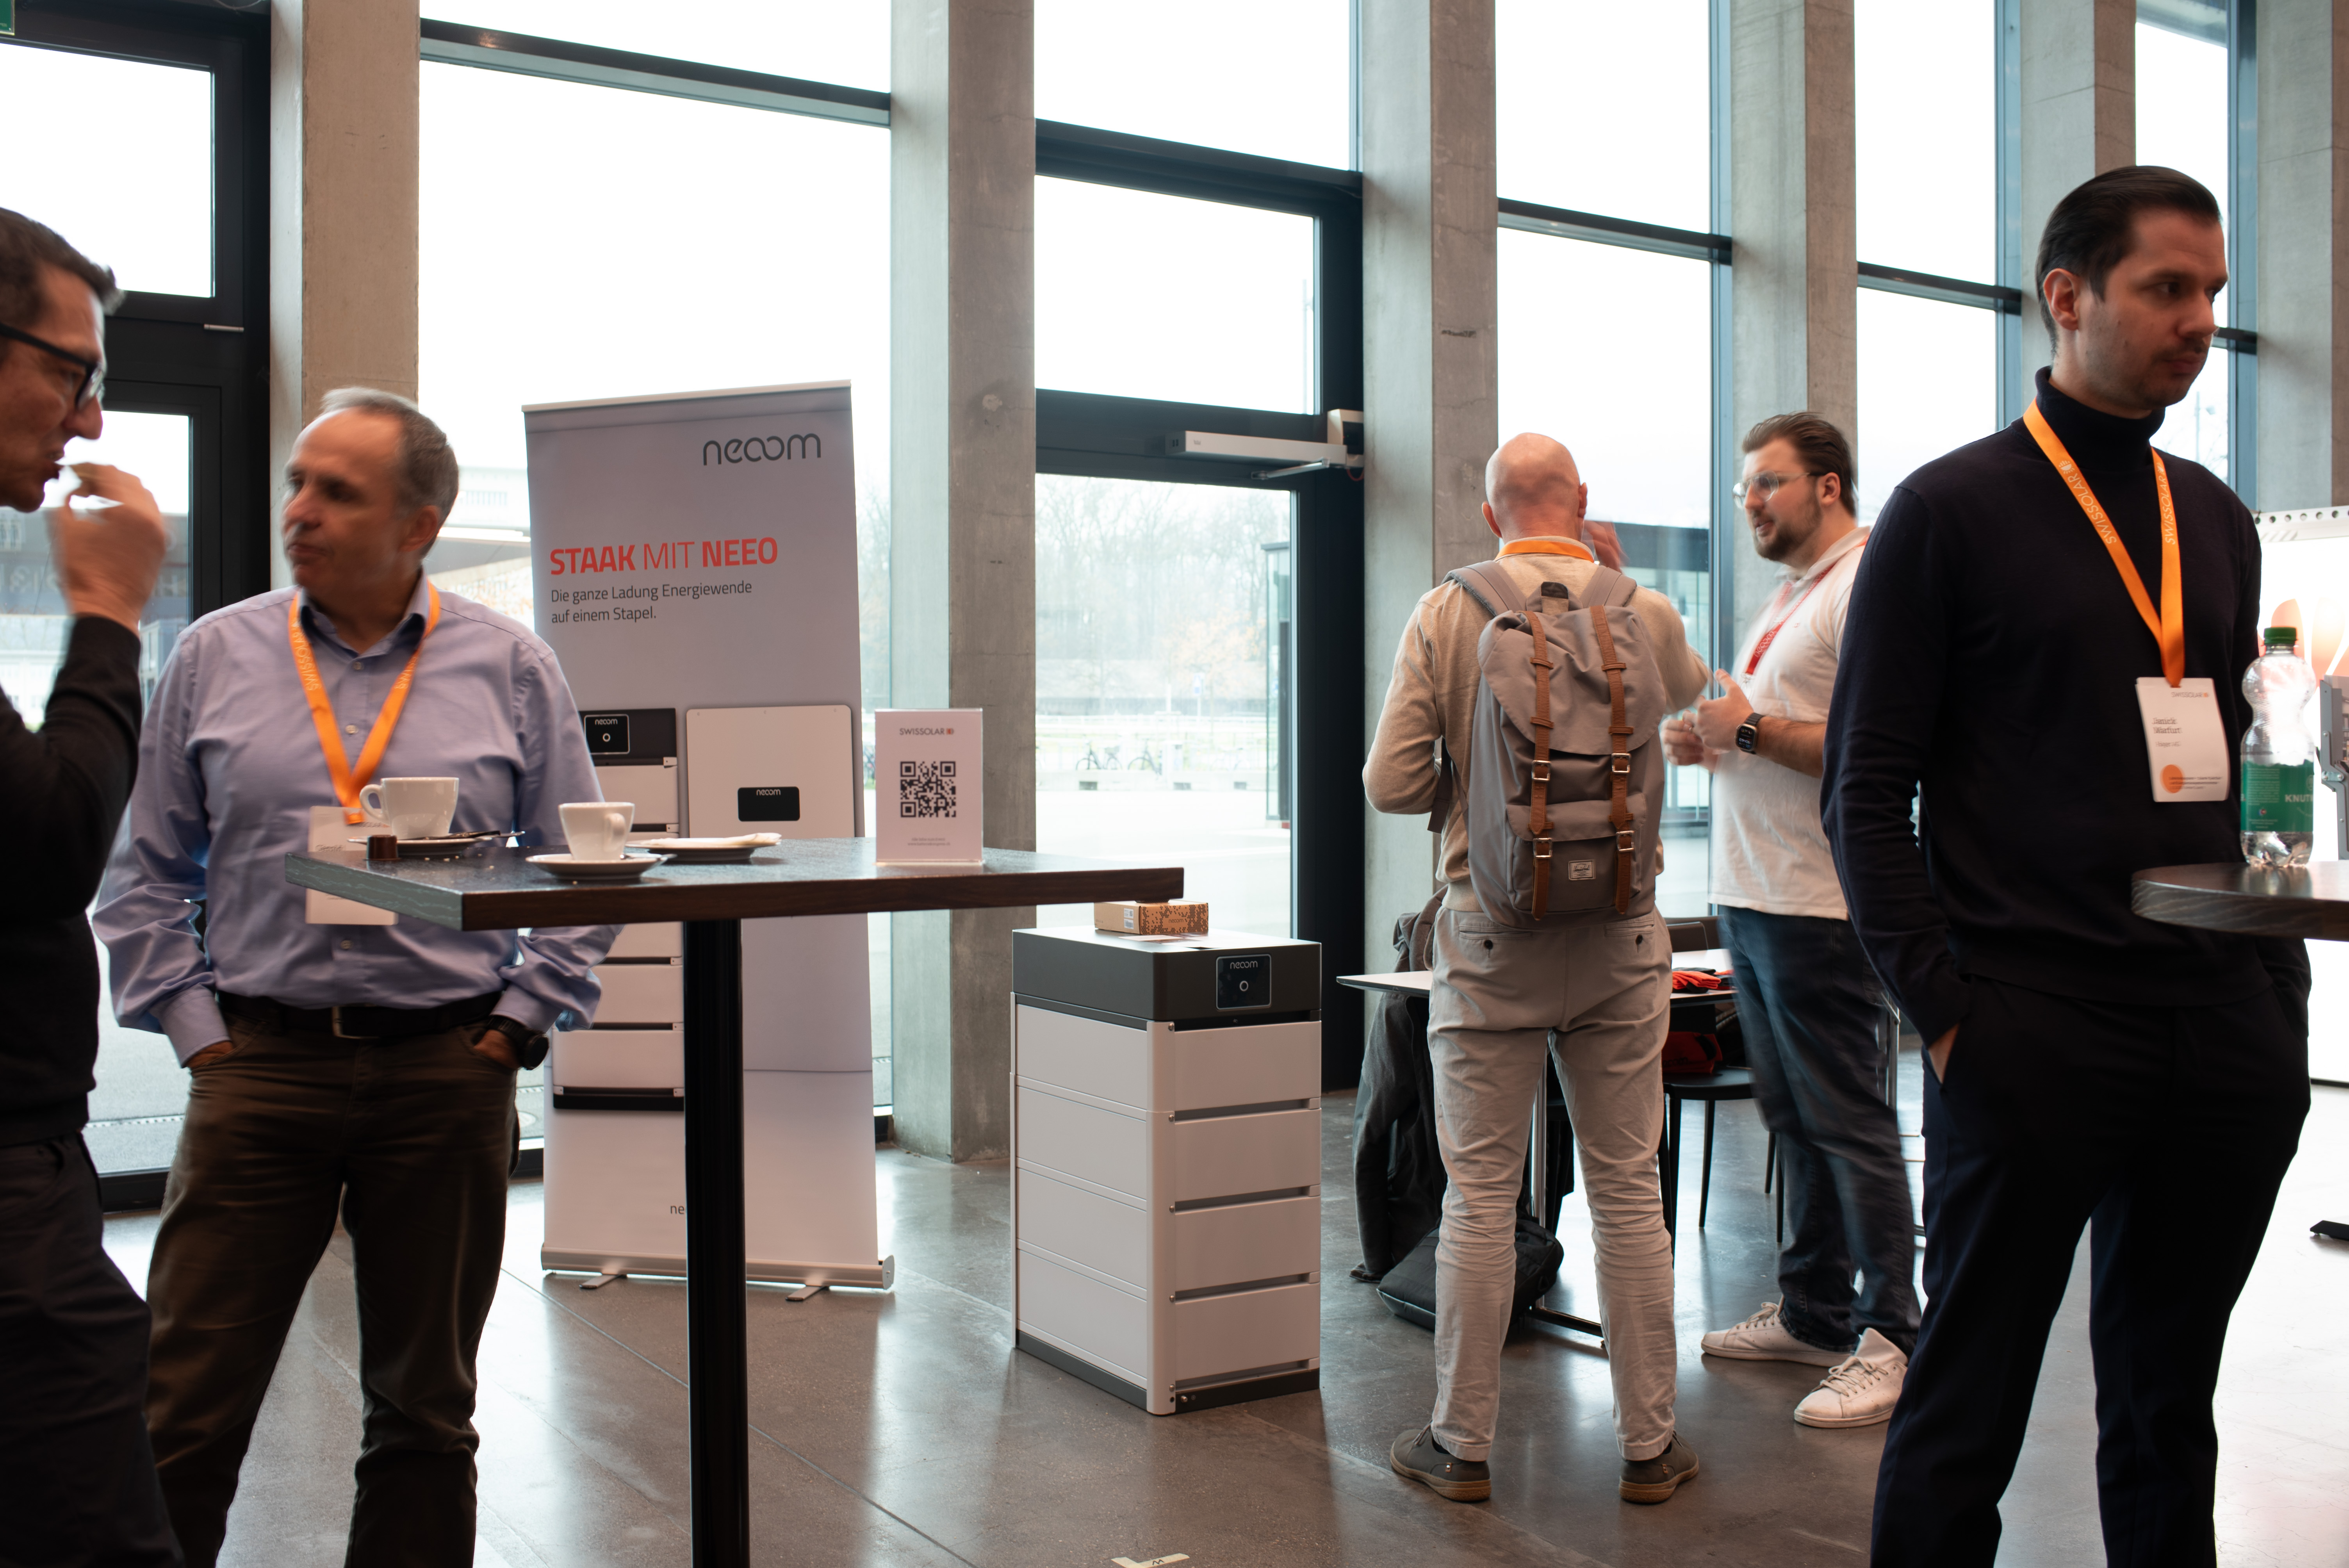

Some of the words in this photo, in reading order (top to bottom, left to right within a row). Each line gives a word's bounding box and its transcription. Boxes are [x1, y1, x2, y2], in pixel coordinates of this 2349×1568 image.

[703, 433, 821, 466] neoom
[2067, 473, 2117, 544] SWISSOLAR
[2158, 476, 2175, 545] SWISSOLAR
[550, 545, 636, 575] STAAK
[643, 541, 695, 570] MIT
[702, 536, 778, 567] NEEO
[552, 589, 569, 602] Die
[573, 590, 608, 605] ganze
[612, 585, 659, 601] Ladung
[663, 580, 752, 599] Energiewende
[552, 609, 570, 623] auf
[573, 609, 610, 622] einem
[613, 606, 656, 623] Stapel.
[1230, 960, 1258, 969] neoom
[670, 1206, 686, 1214] ne
